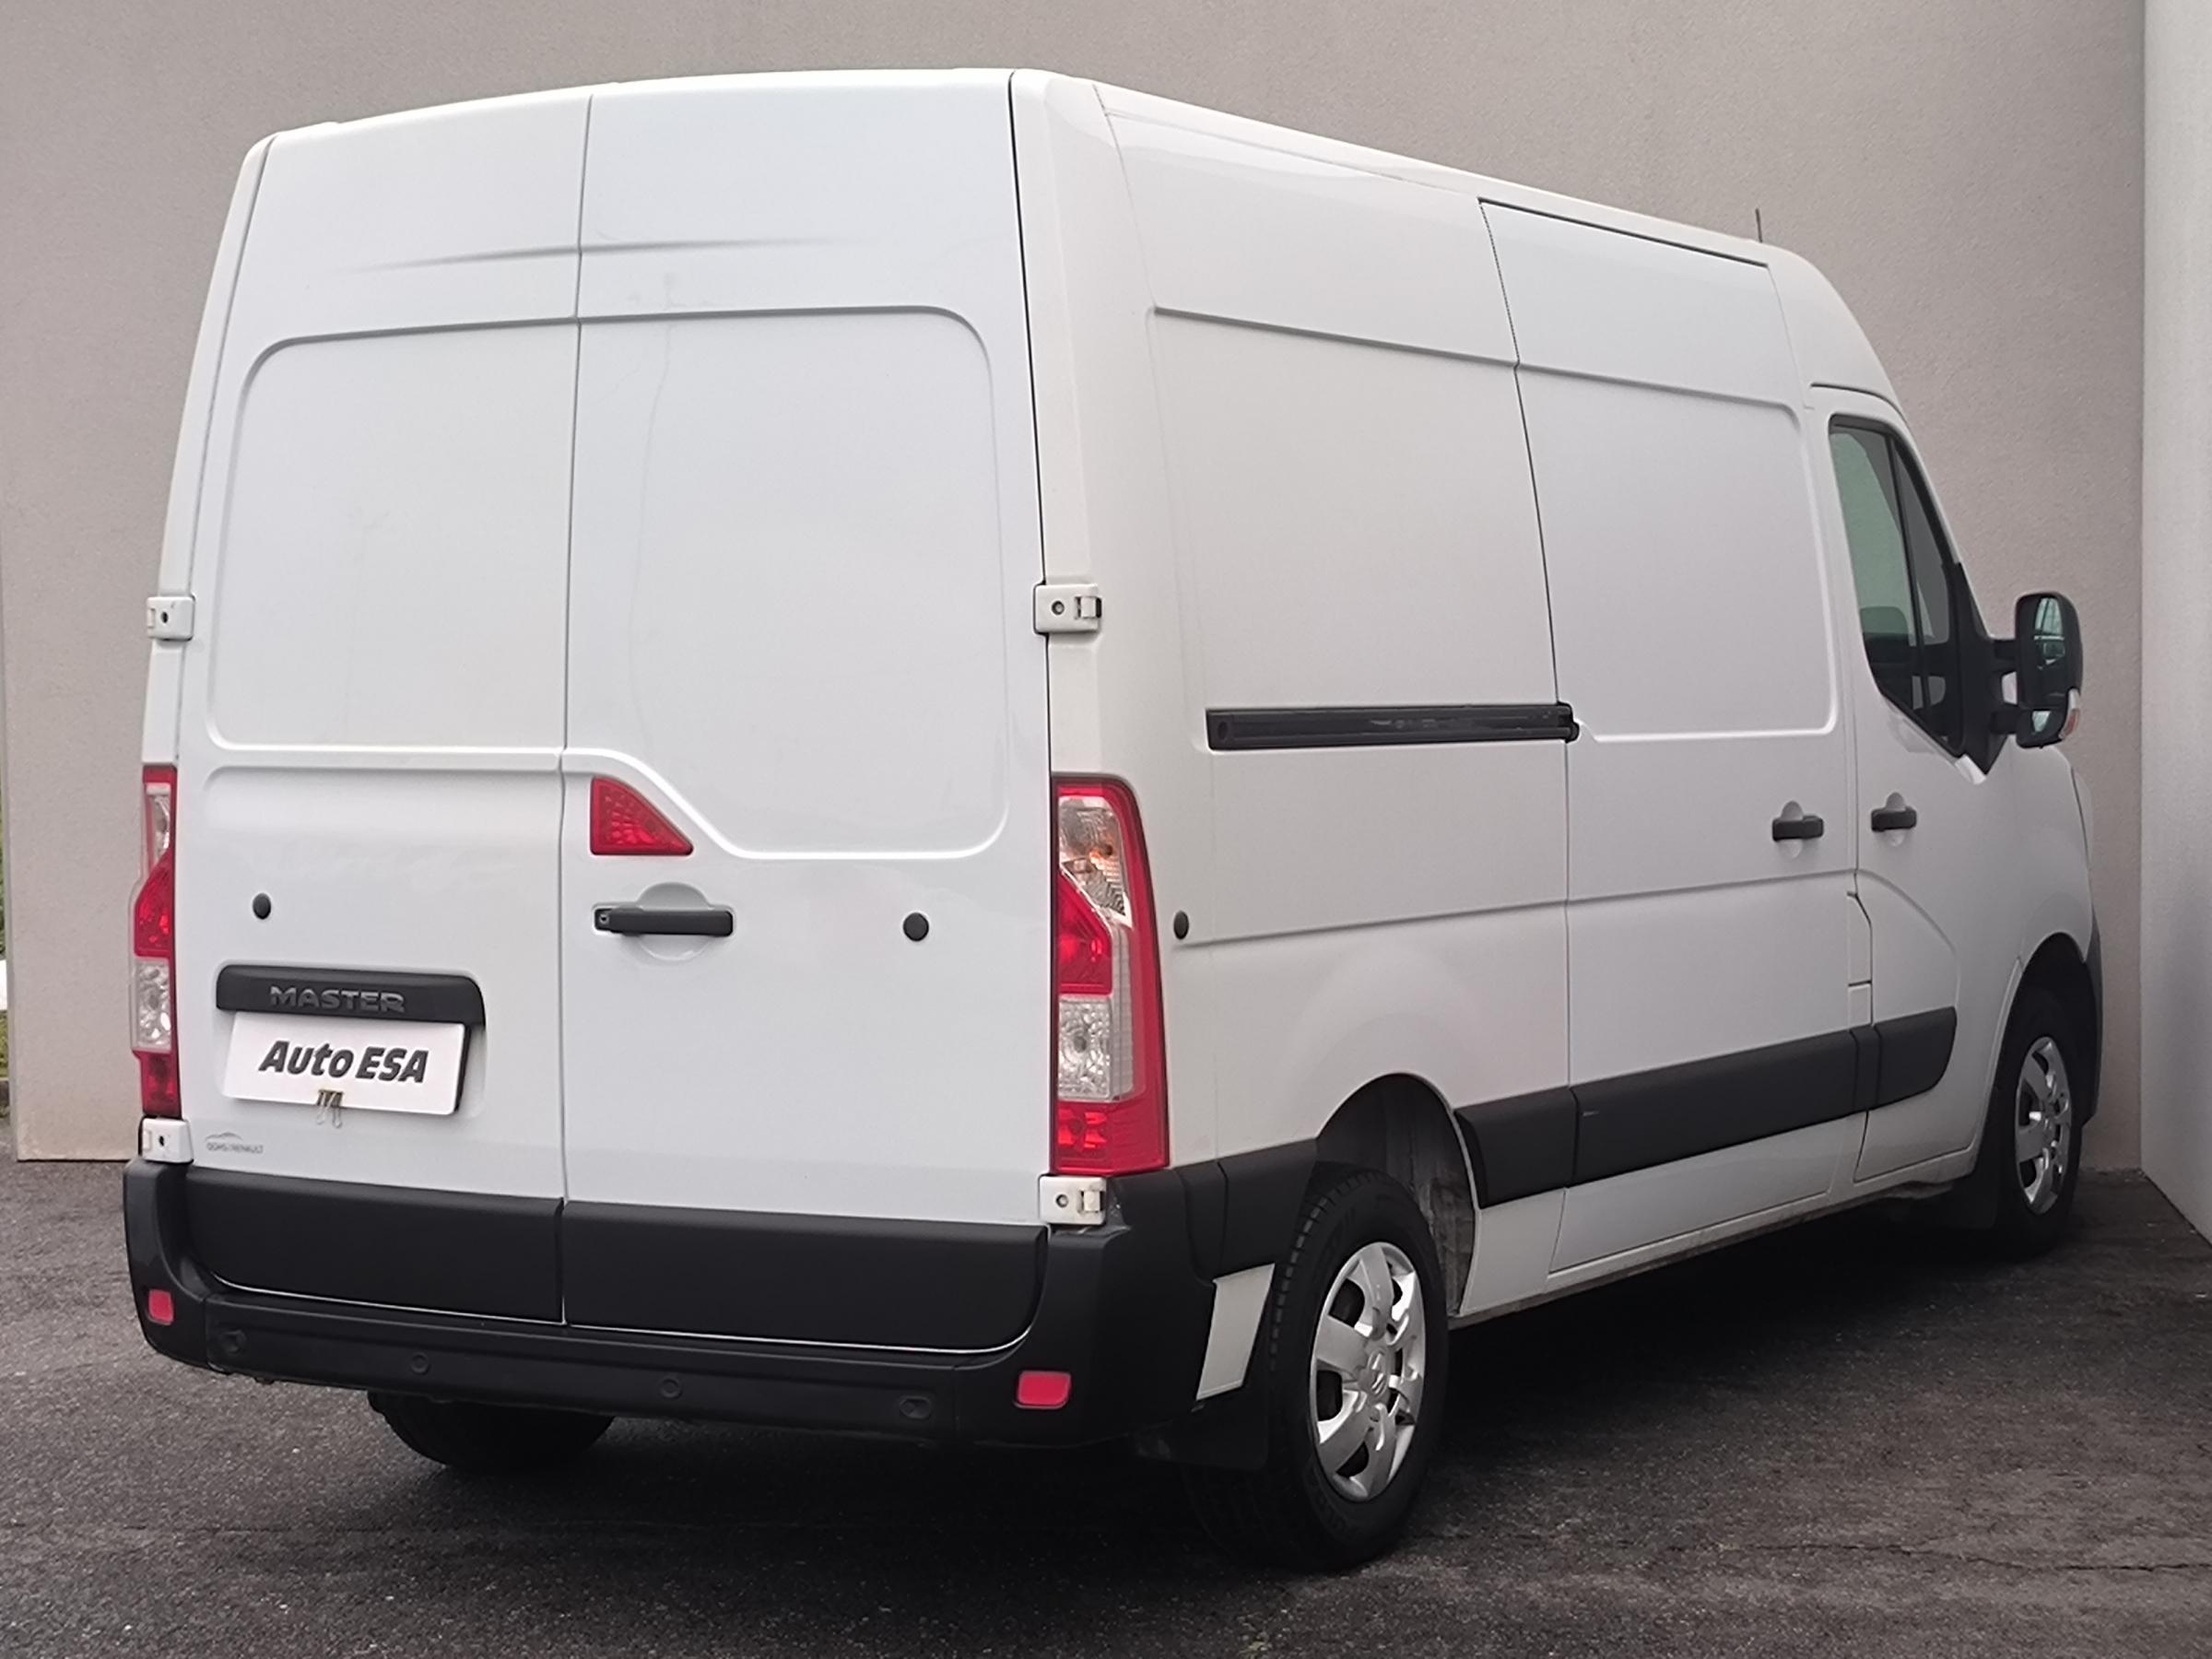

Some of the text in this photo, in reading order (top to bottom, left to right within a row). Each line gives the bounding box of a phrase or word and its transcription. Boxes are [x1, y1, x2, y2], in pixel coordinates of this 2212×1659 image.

[270, 986, 405, 1012] MASTER
[258, 1041, 429, 1083] Auto ESA
